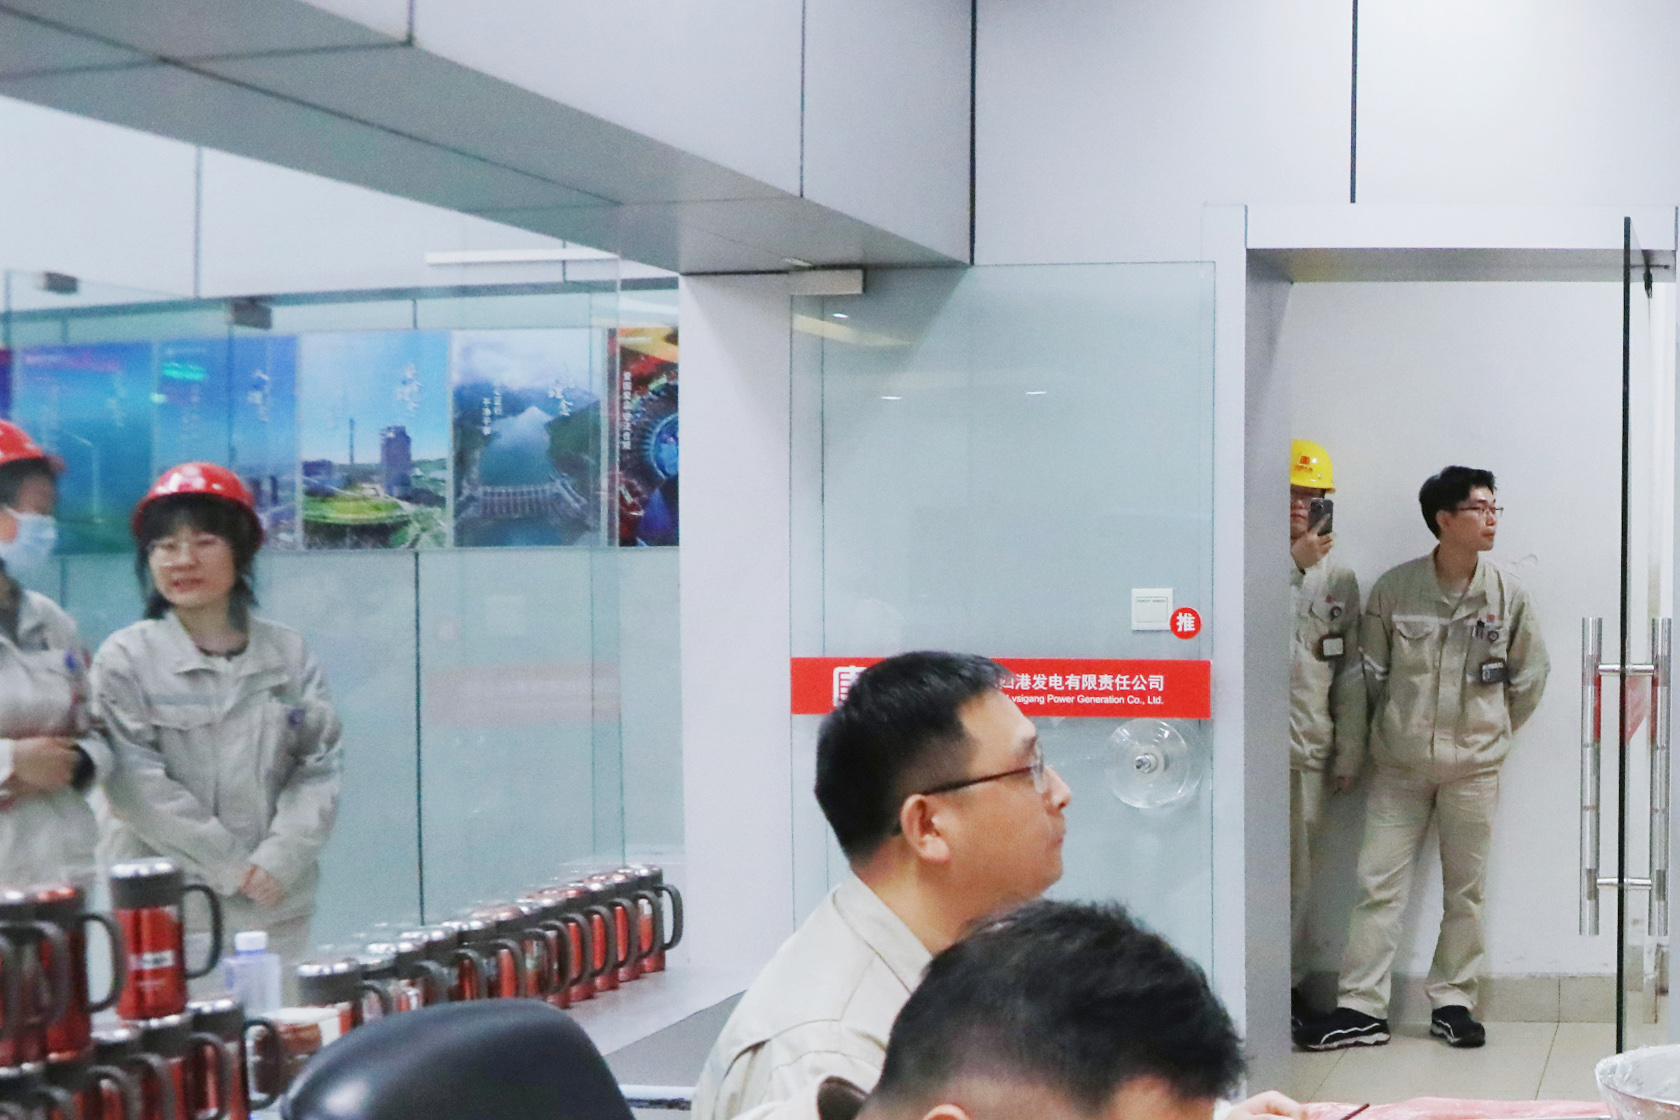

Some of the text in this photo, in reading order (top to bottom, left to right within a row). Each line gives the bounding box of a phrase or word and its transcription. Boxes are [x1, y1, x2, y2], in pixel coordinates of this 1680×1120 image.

[1177, 612, 1196, 632] 推
[1006, 694, 1164, 705] vsigang Power Generation Co., Ltd.
